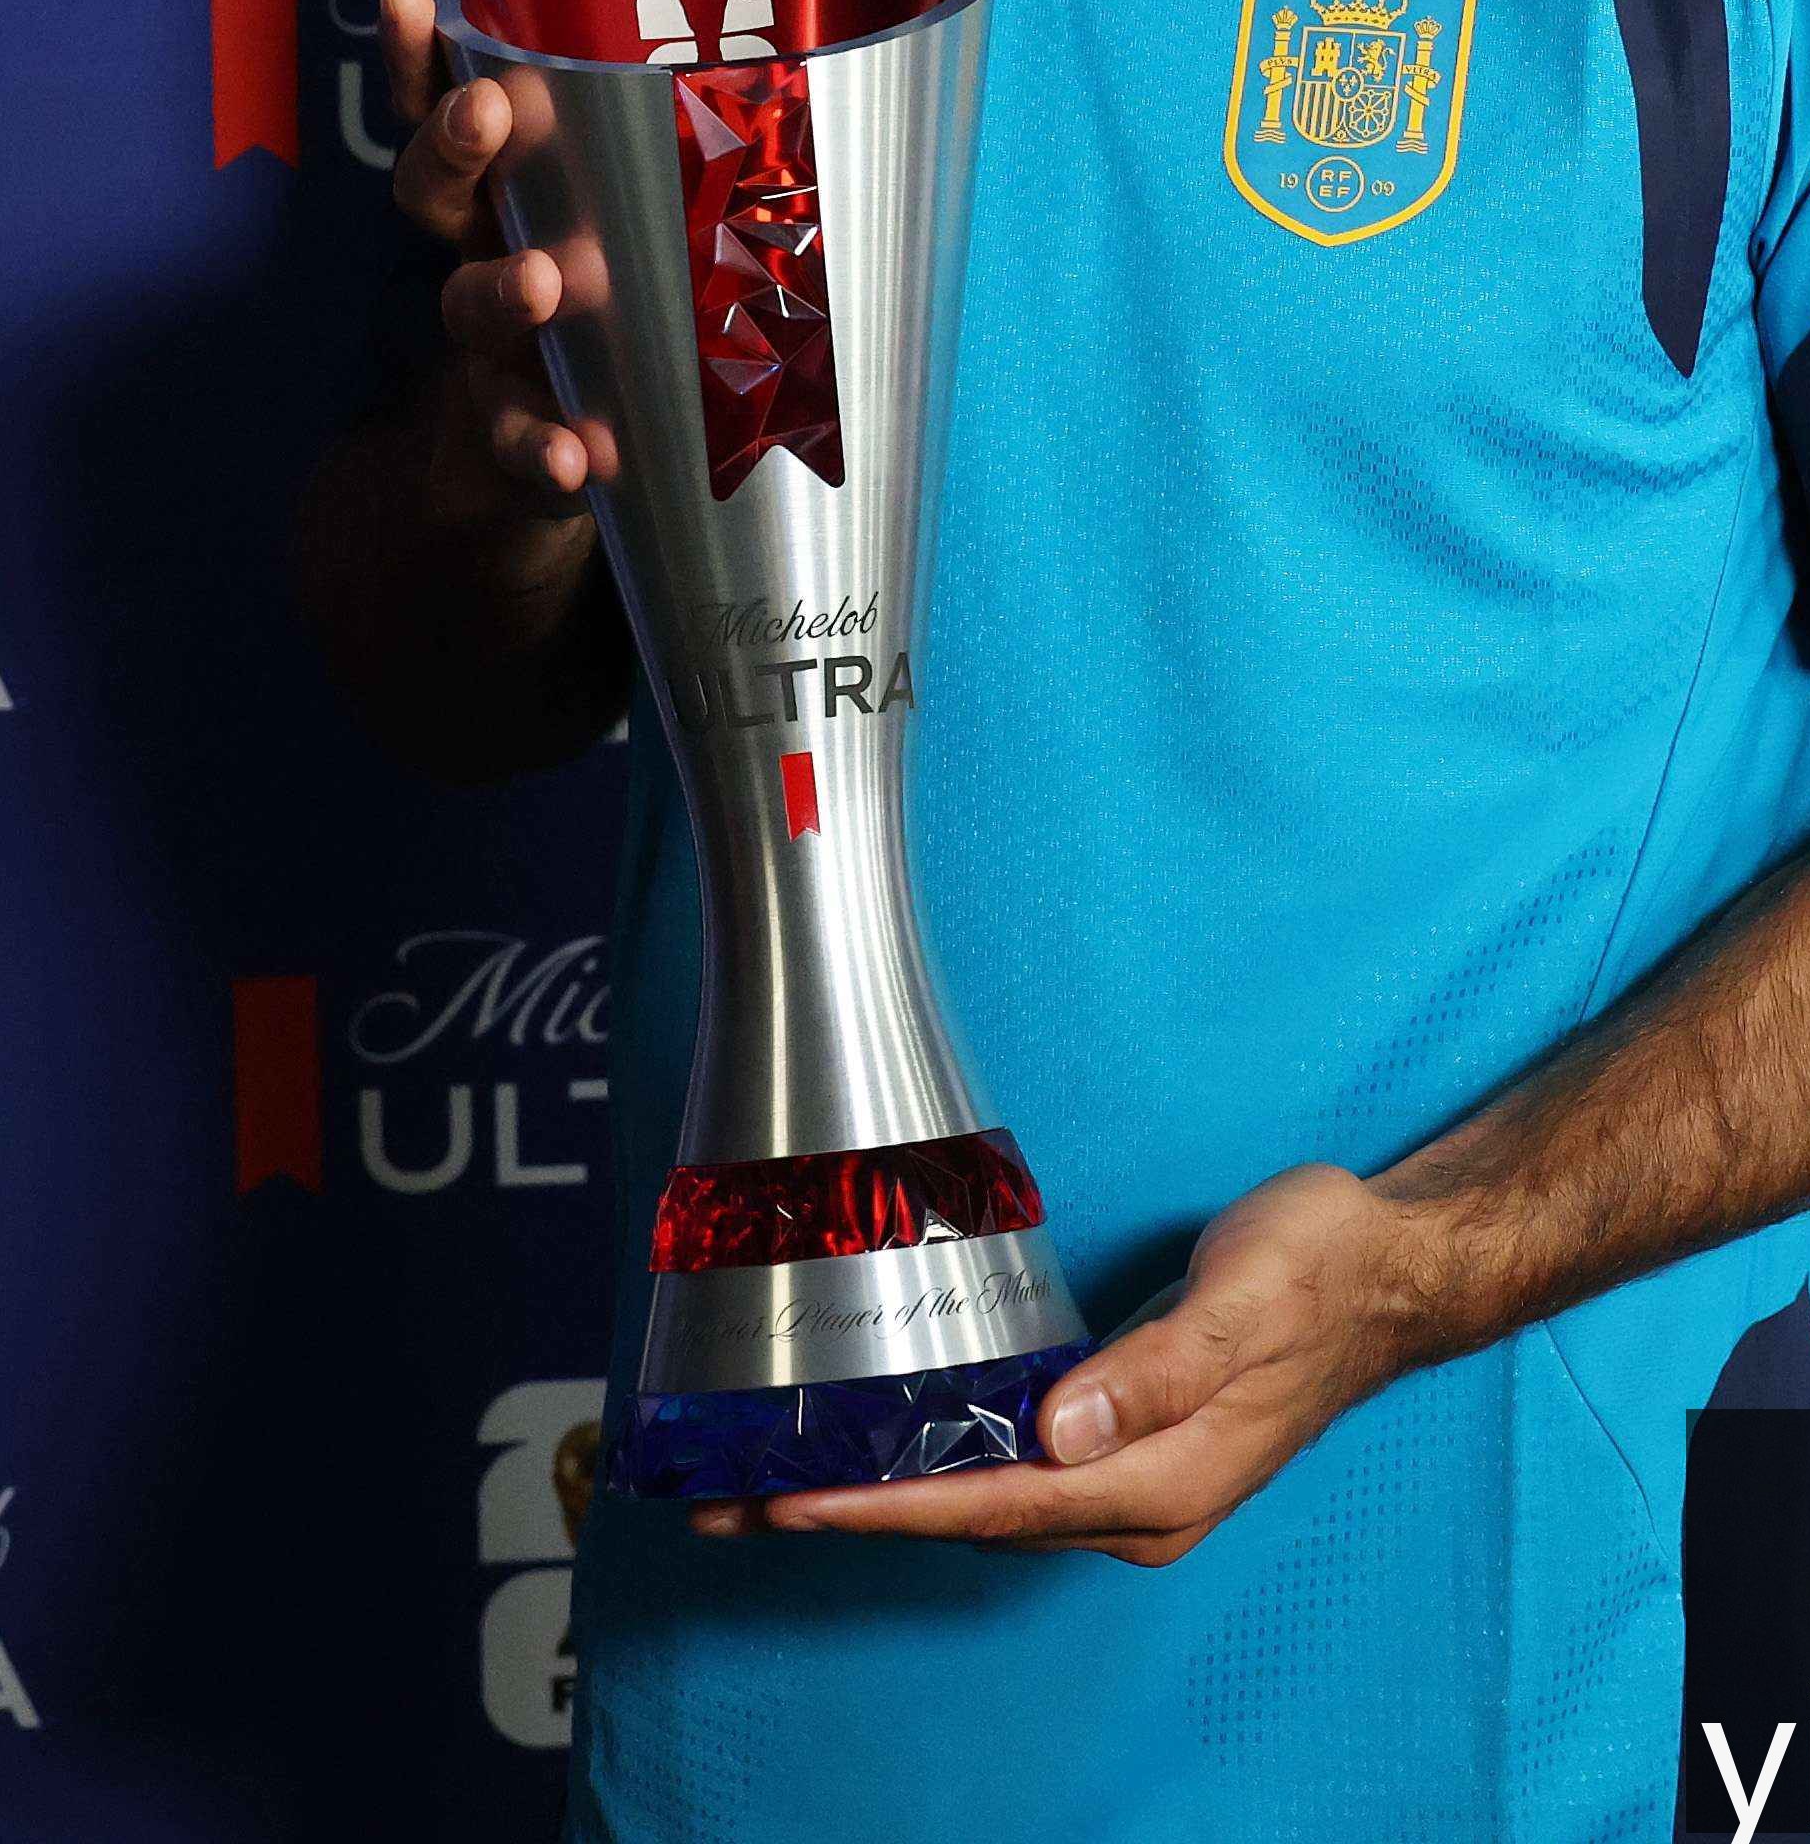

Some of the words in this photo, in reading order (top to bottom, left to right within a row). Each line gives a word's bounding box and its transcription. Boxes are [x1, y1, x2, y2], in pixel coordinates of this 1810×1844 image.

[1279, 172, 1299, 189] 19
[769, 1299, 884, 1341] Player
[928, 1288, 970, 1318] the
